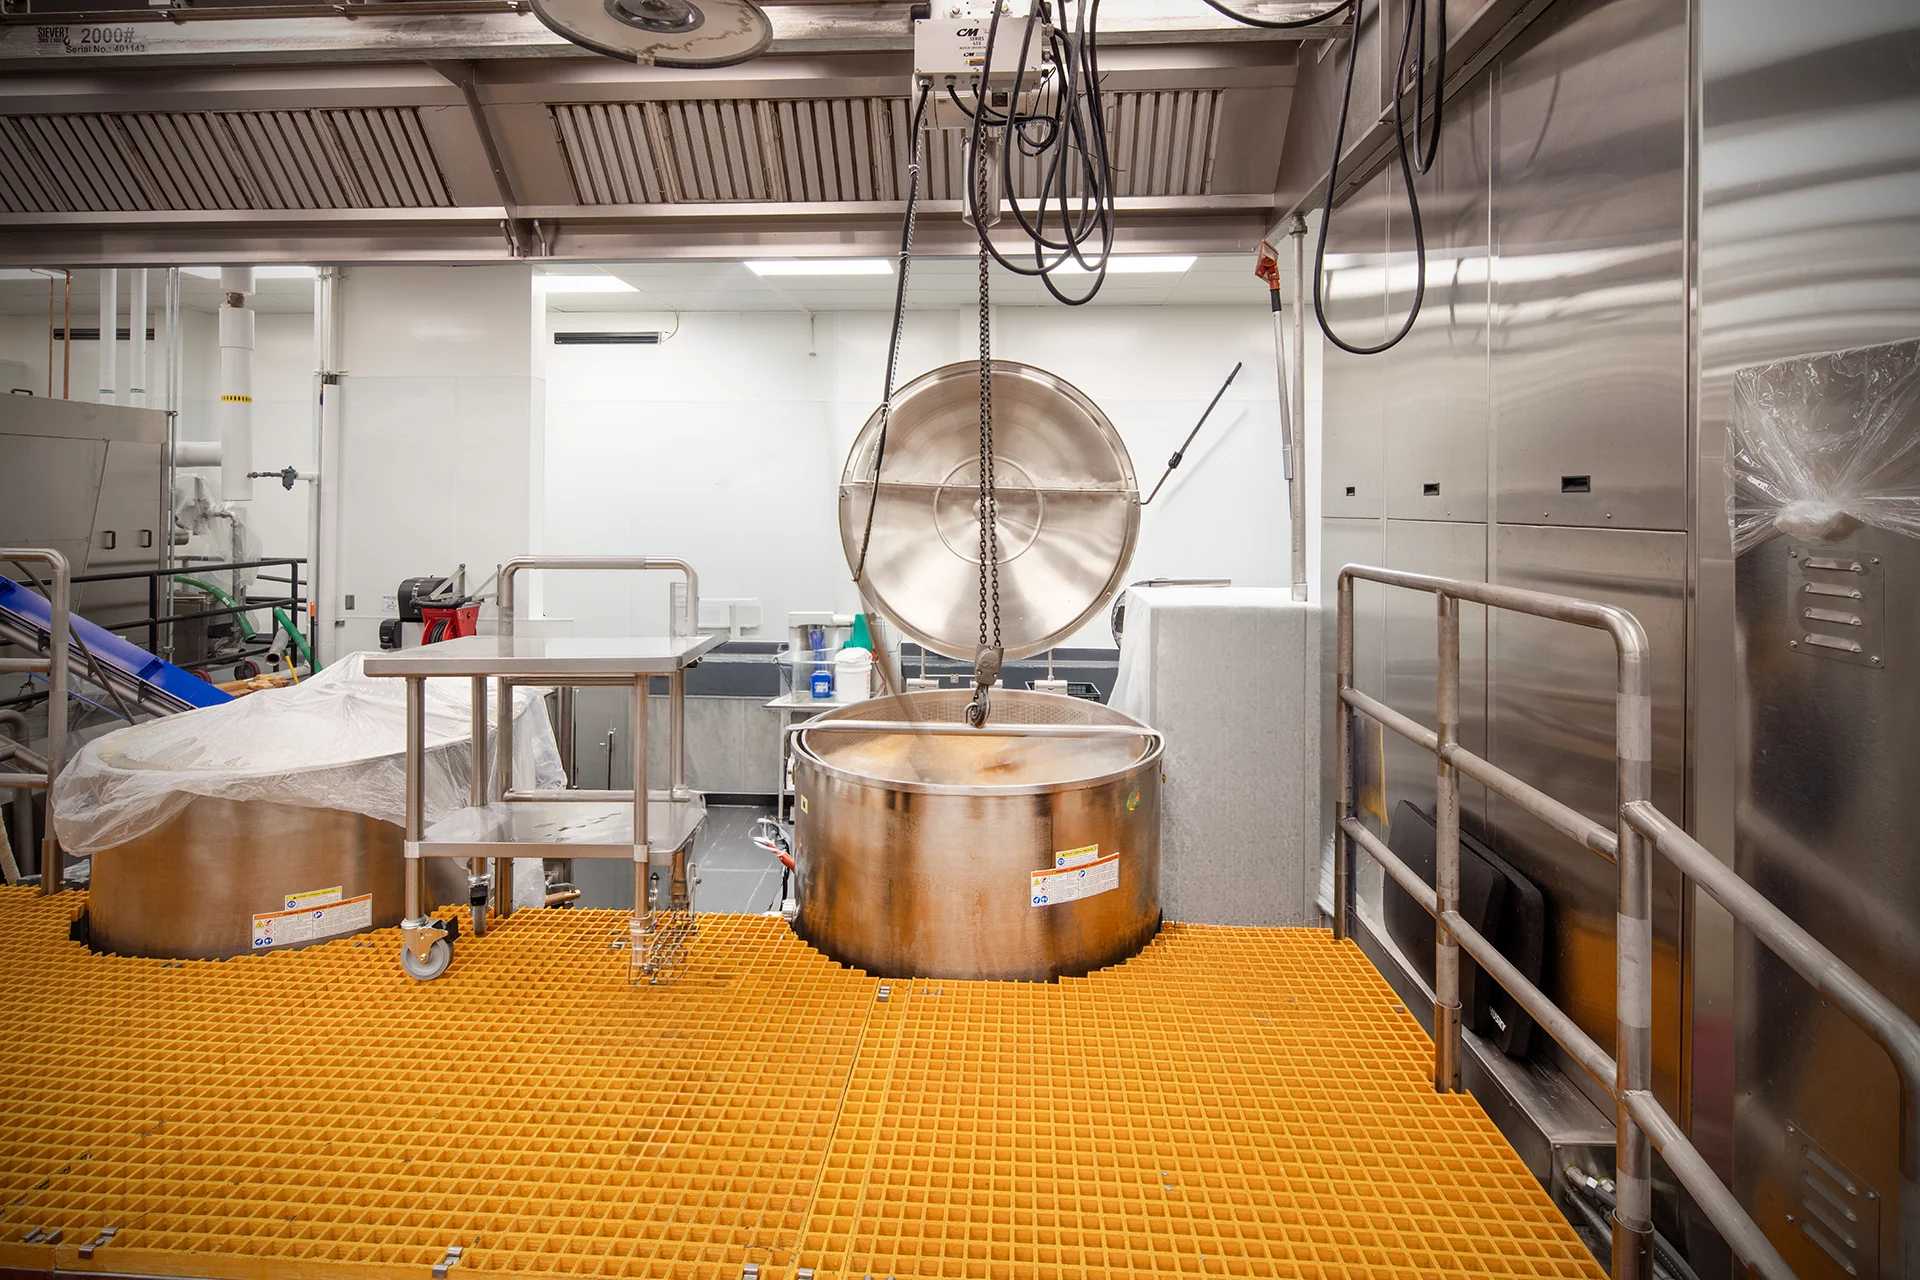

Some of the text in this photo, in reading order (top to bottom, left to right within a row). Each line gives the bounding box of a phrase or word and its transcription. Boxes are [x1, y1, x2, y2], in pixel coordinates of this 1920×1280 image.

[38, 26, 70, 39] SIEVERT
[81, 27, 135, 43] 2000#
[956, 28, 980, 37] CM
[66, 45, 92, 53] Serial
[94, 45, 111, 53] No.:
[114, 44, 145, 53] 401143
